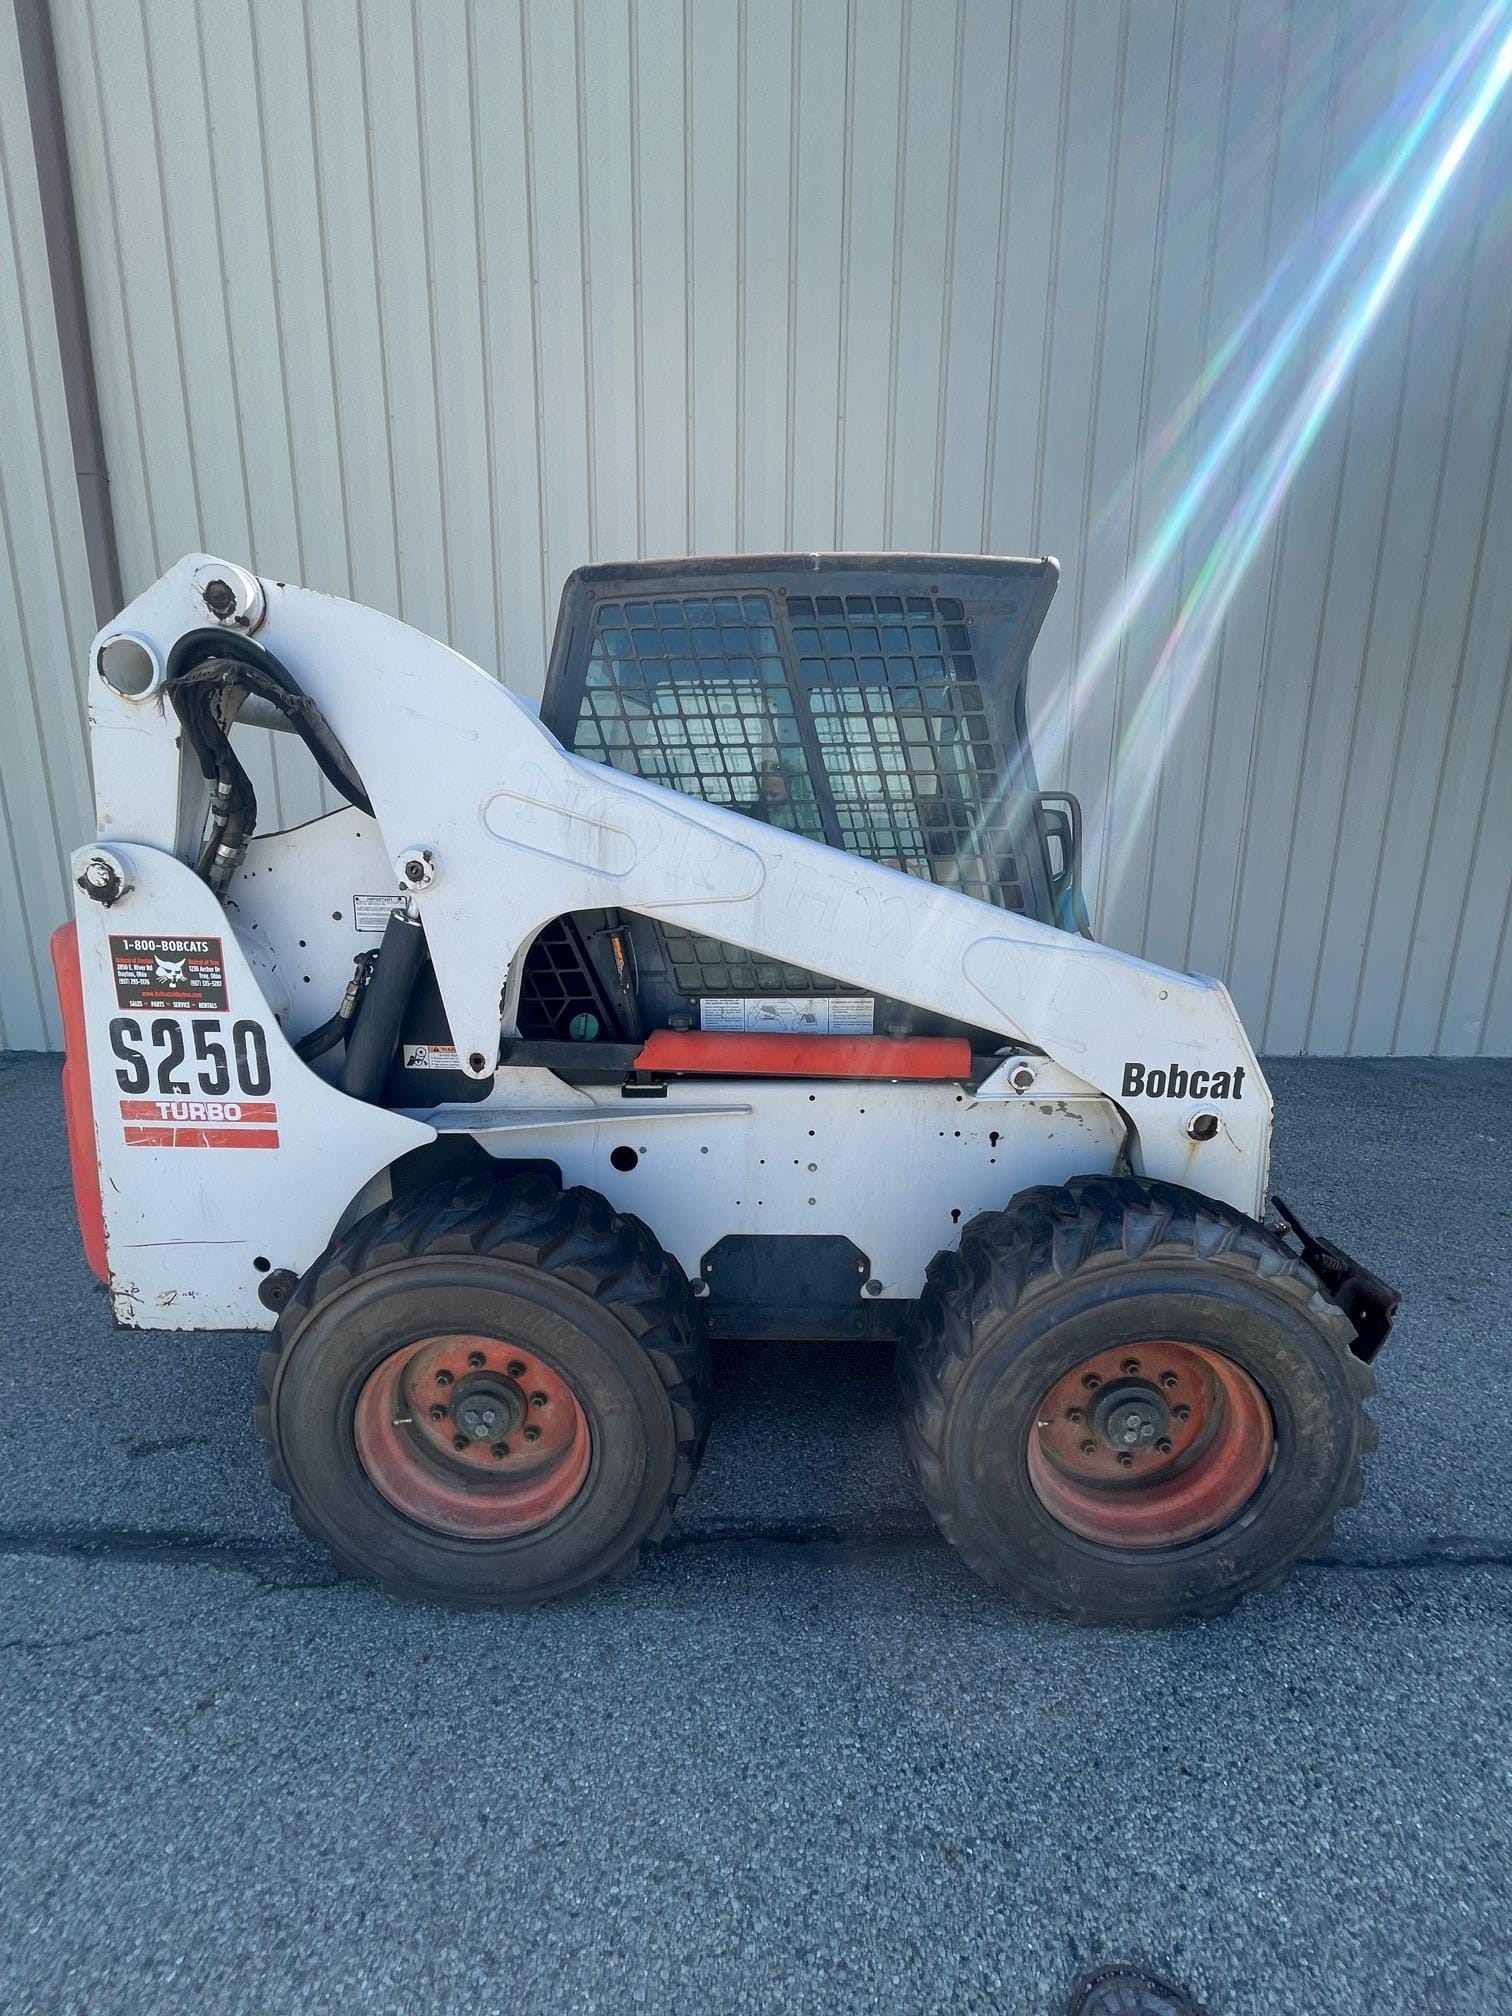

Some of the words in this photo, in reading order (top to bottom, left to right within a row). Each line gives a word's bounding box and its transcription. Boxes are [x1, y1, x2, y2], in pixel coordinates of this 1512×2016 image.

[122, 939, 209, 952] 1-800-BOBCATS
[109, 1017, 271, 1096] S250
[1121, 1062, 1245, 1099] Bobcat
[155, 1102, 242, 1121] TURBO
